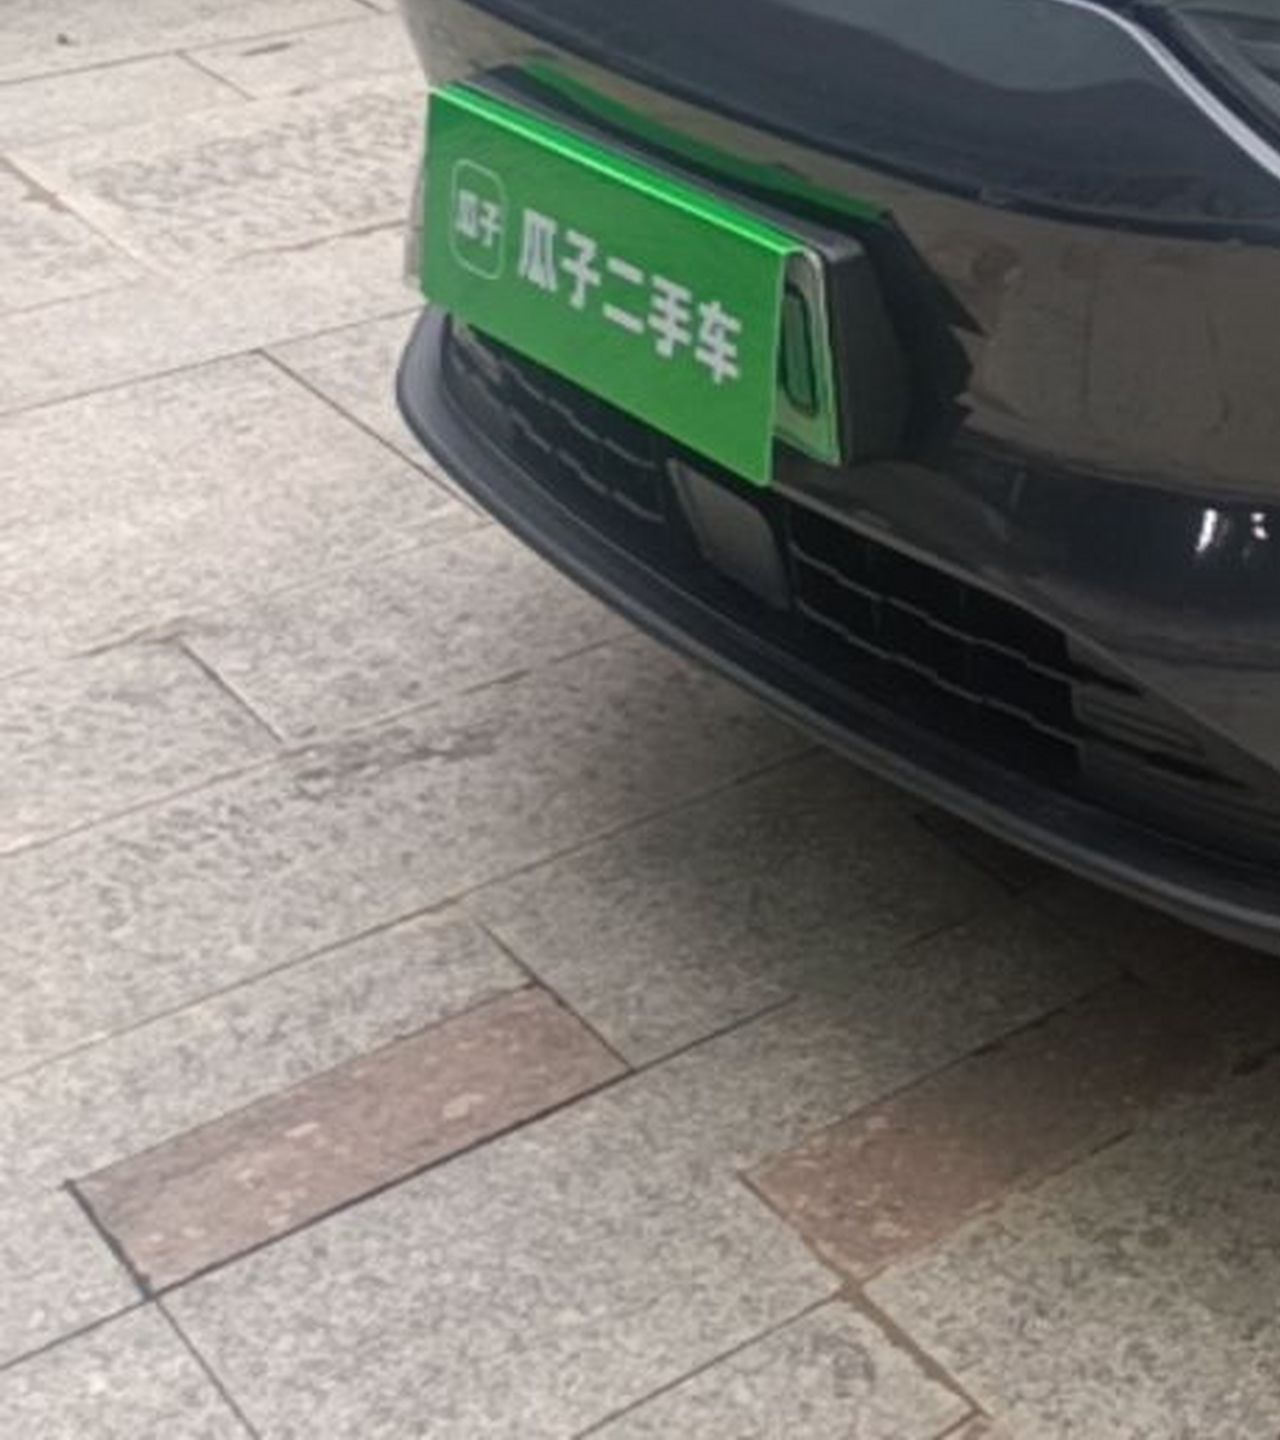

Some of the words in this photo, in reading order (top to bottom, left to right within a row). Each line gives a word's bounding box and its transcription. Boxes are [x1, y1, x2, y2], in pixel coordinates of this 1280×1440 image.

[454, 190, 501, 247] 瓜子
[518, 208, 743, 384] 瓜子二手车
